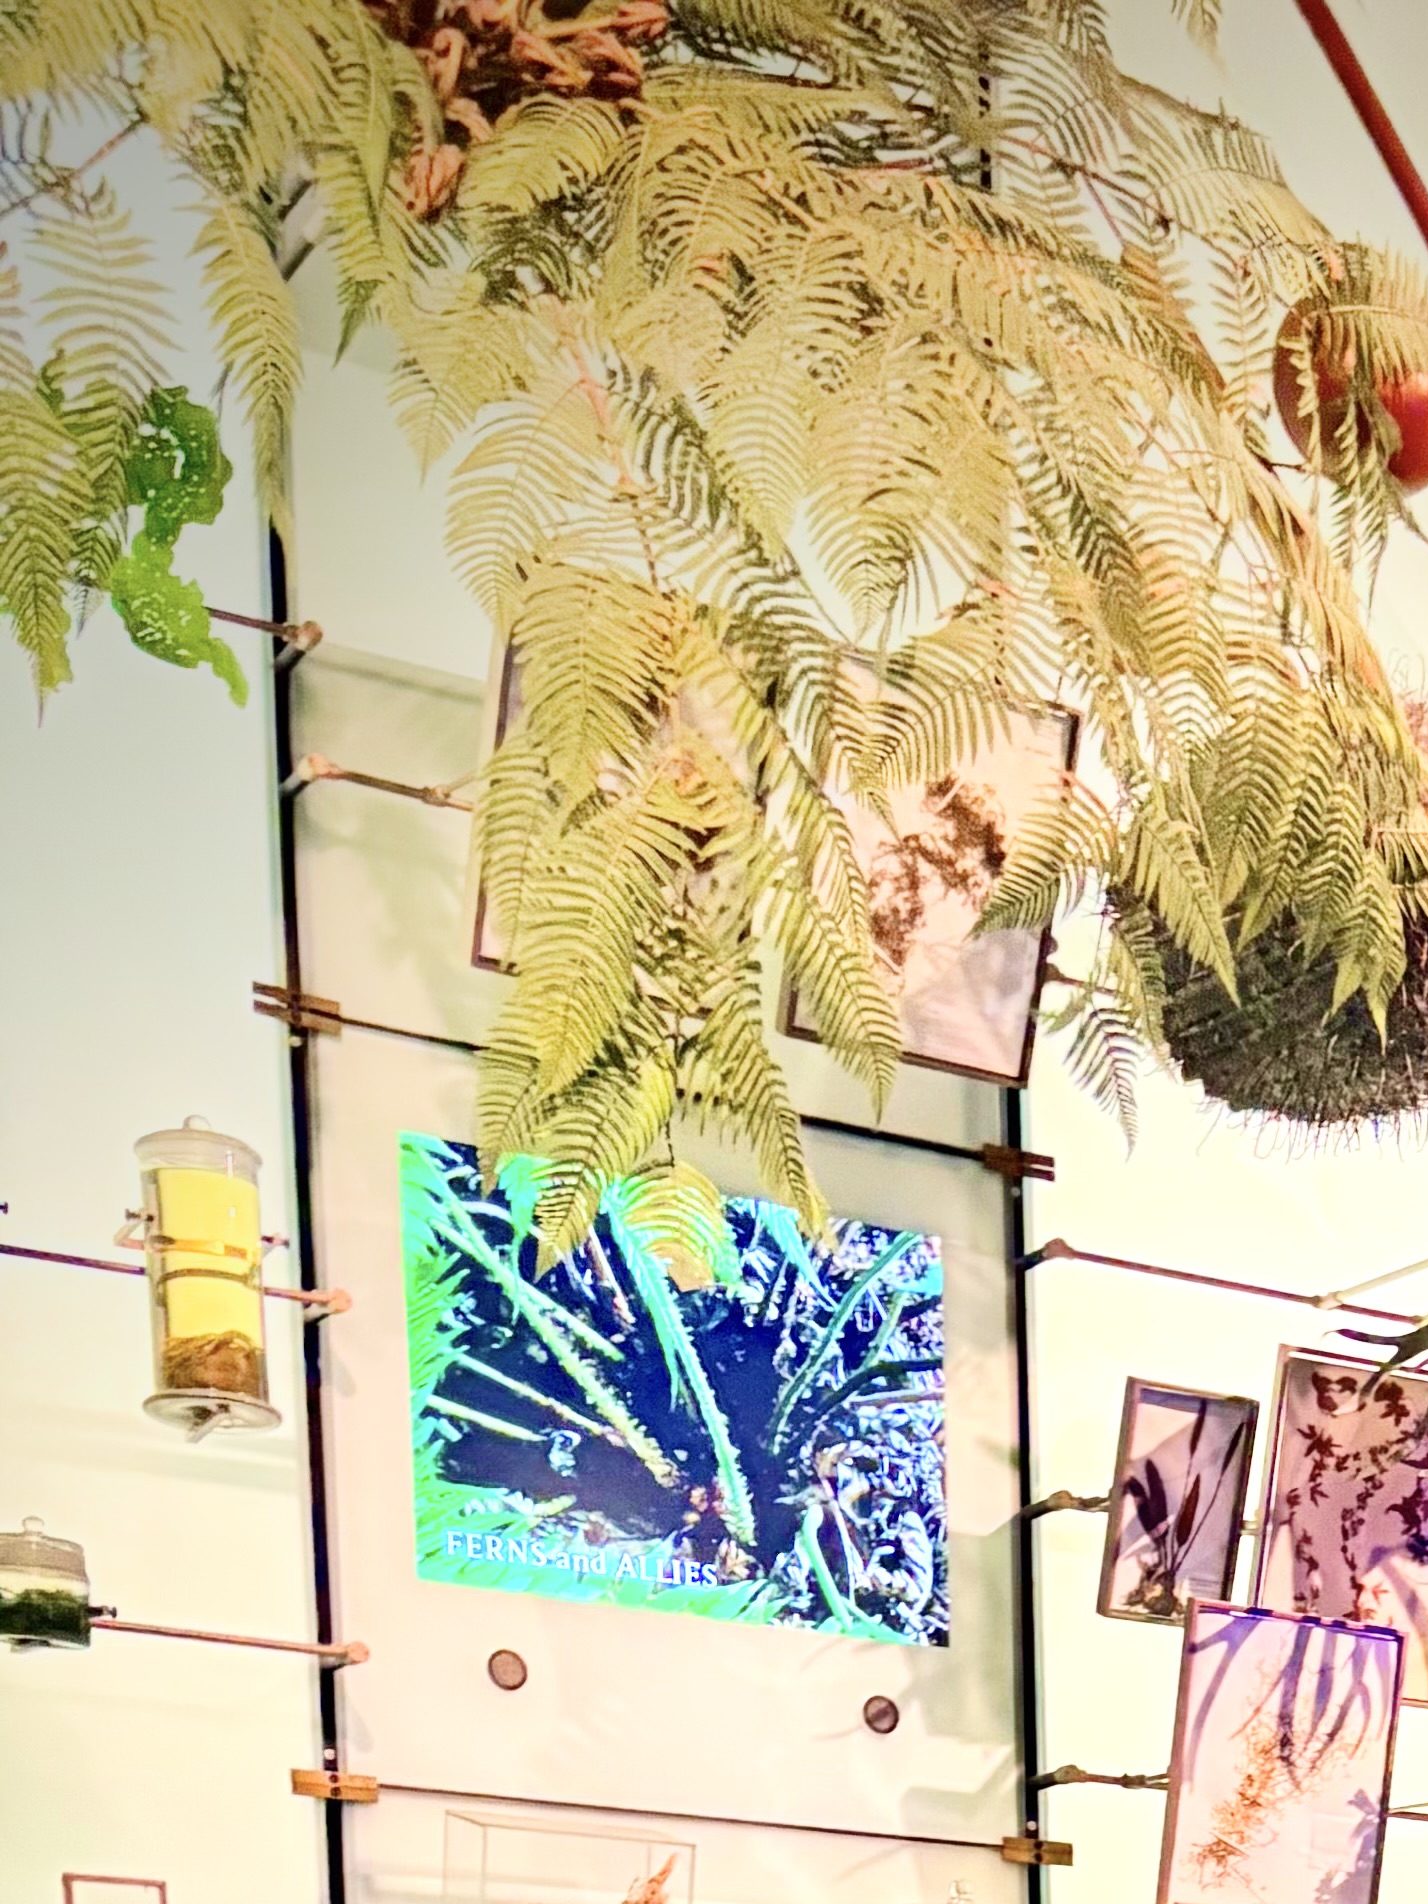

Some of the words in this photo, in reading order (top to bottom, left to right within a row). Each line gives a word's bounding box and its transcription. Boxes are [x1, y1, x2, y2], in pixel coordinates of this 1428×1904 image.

[446, 1530, 548, 1567] FERNS
[554, 1552, 607, 1575] and
[615, 1552, 719, 1588] ALLIES
